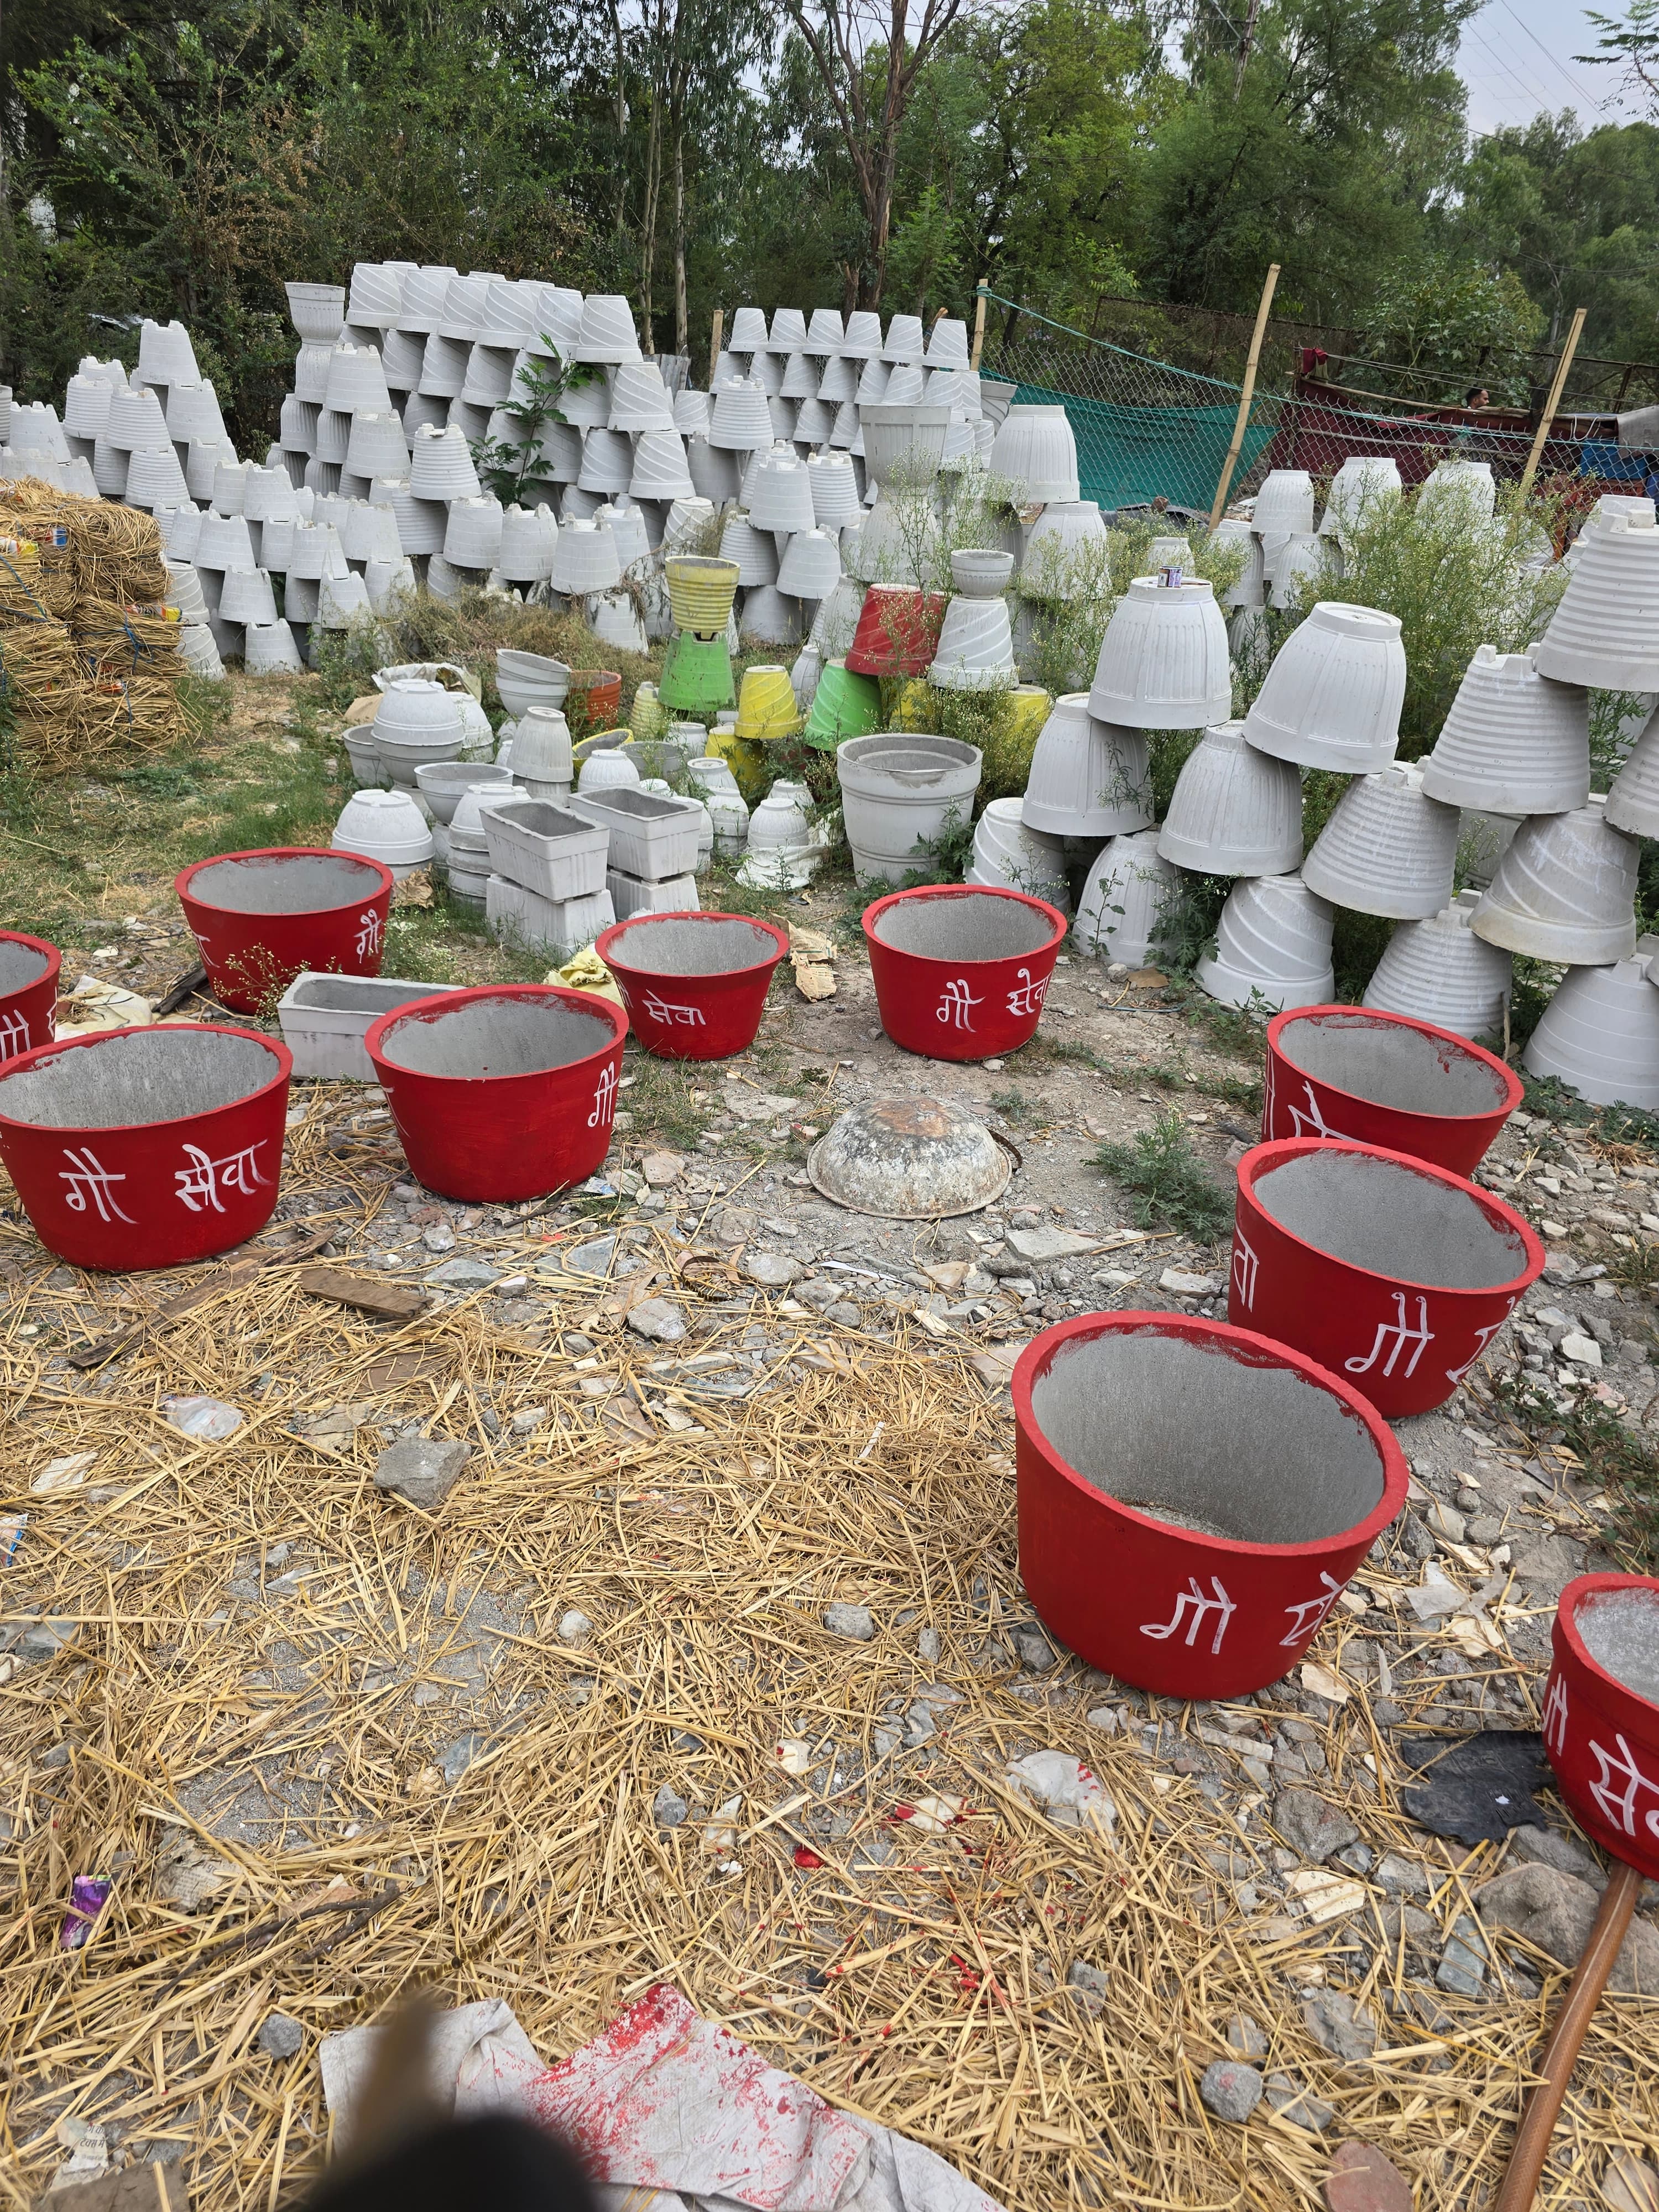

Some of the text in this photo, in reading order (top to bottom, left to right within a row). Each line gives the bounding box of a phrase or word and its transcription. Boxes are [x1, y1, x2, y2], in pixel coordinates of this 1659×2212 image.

[642, 989, 706, 1025] सेवा
[936, 968, 1053, 1032] गौ सेवा
[587, 1061, 620, 1127] गौ
[59, 1147, 140, 1224] गौ
[1344, 1292, 1434, 1378] गौ
[1139, 1576, 1237, 1655] गौ
